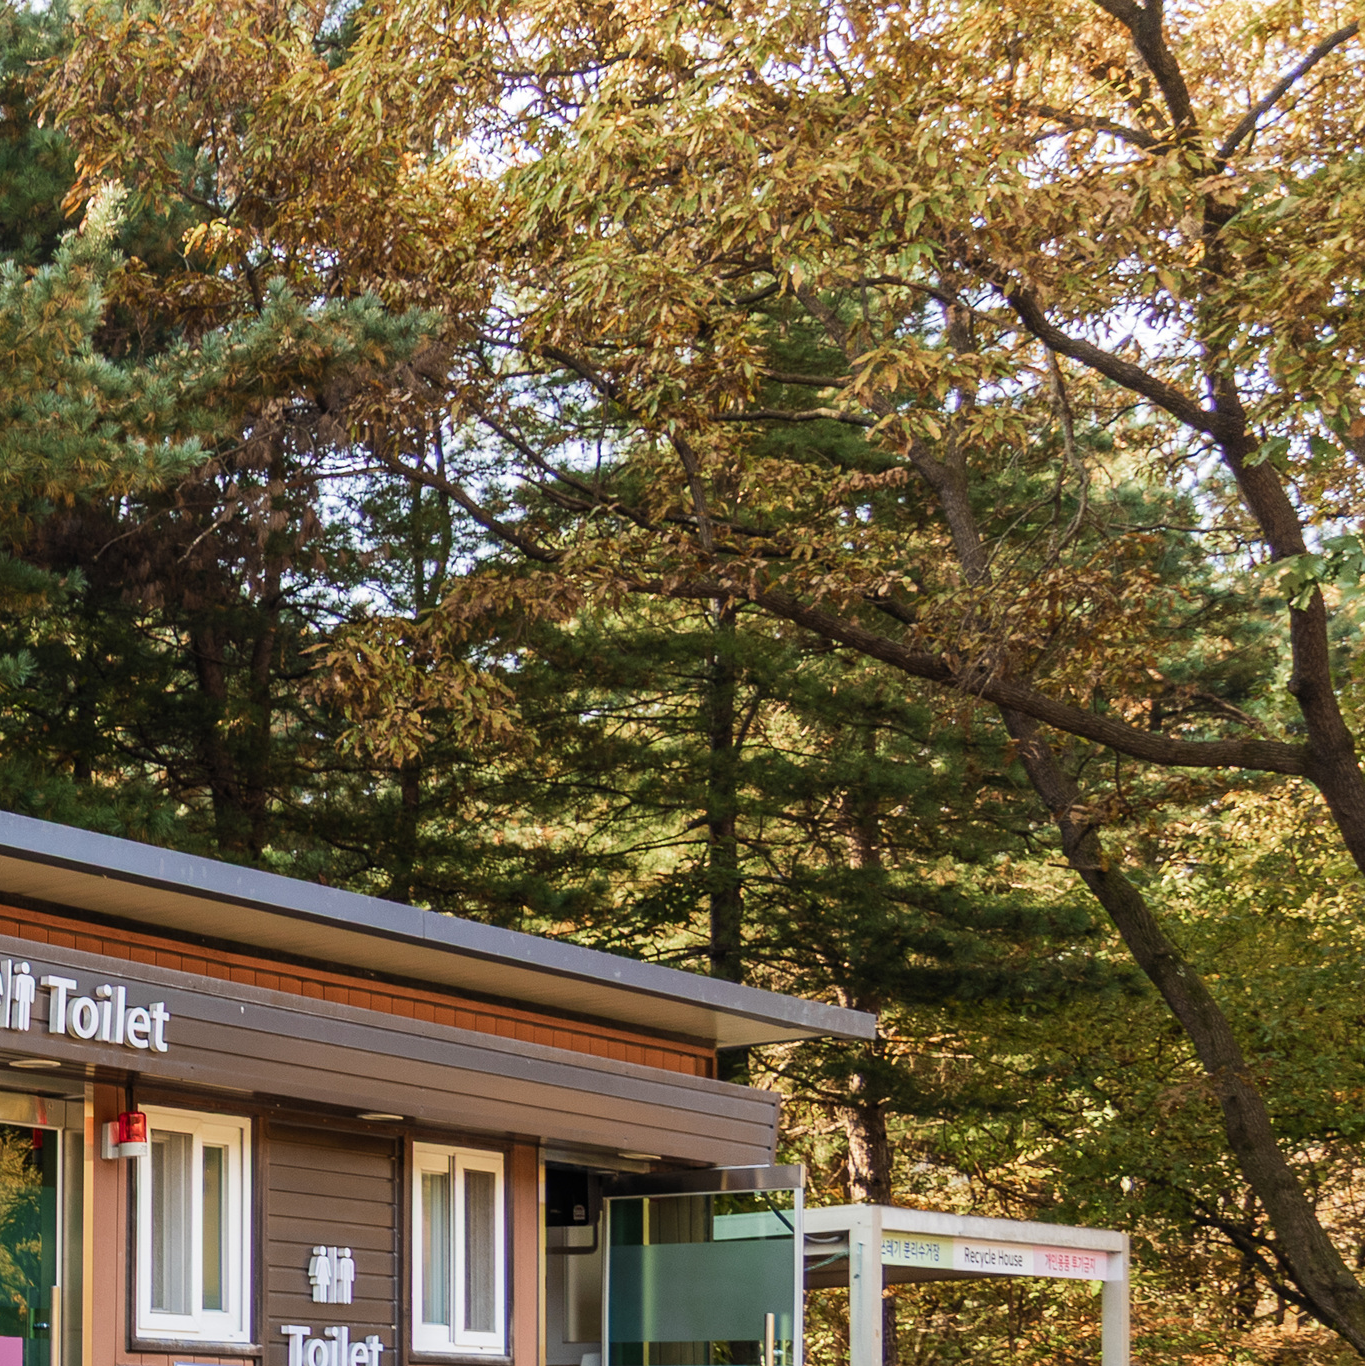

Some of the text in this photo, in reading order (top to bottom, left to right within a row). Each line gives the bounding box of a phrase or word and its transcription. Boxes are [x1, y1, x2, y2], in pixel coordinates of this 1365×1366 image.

[40, 975, 170, 1052] Toilet
[903, 1241, 940, 1262] 분리수거장
[964, 1247, 1023, 1268] Recycle House
[1045, 1253, 1096, 1274] 개인용품 투기금지
